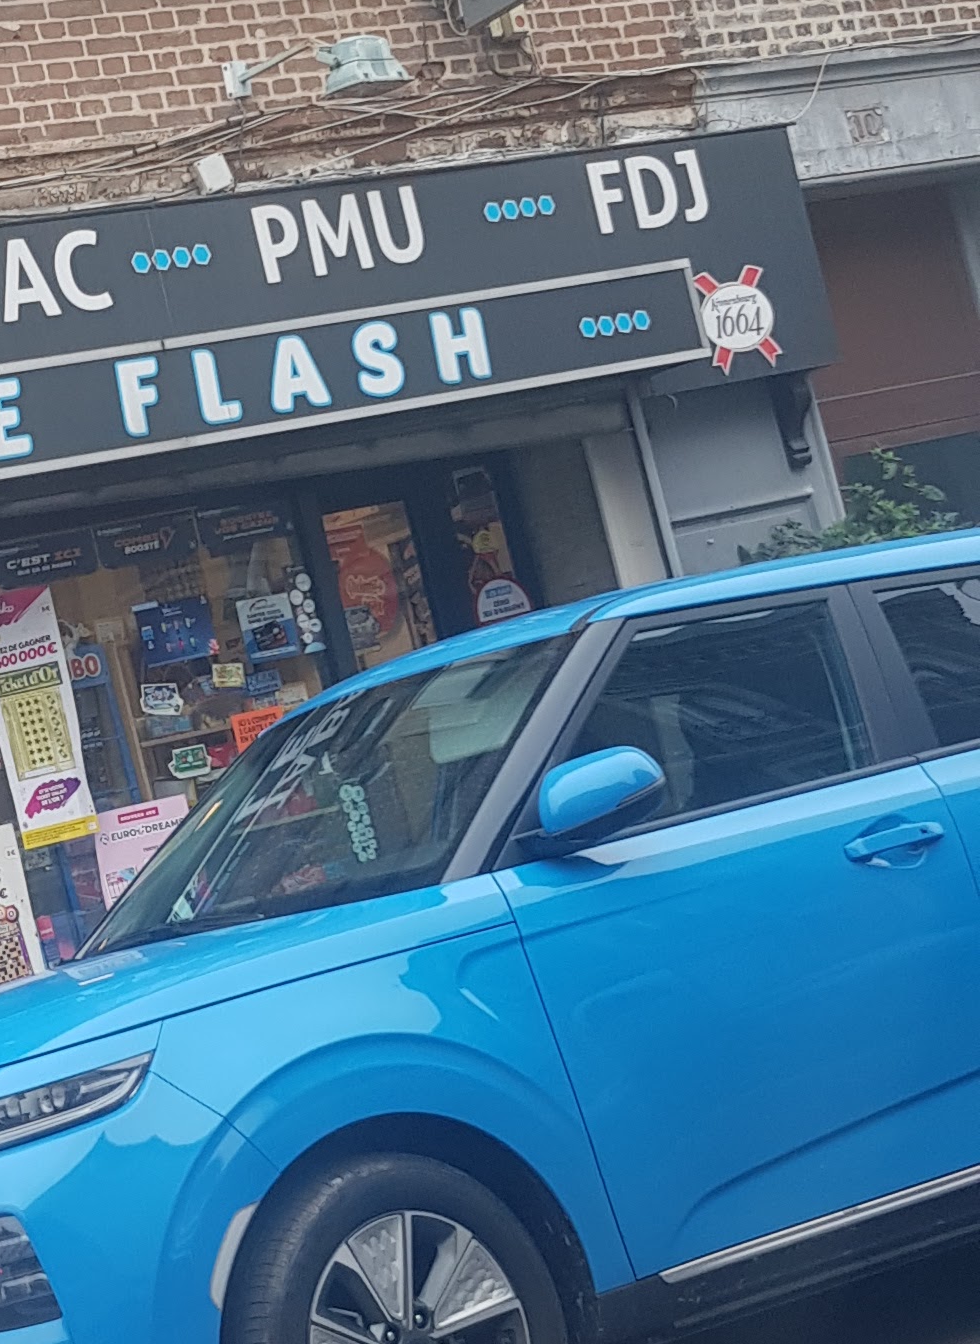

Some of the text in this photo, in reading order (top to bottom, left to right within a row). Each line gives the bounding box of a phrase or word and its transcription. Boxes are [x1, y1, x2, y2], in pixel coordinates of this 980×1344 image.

[250, 186, 425, 284] PMU
[586, 150, 710, 234] FDJ
[716, 304, 764, 339] 1664
[115, 307, 492, 437] FLASH
[19, 642, 58, 662] 000€
[70, 654, 100, 678] BO
[29, 666, 59, 684] d'Or
